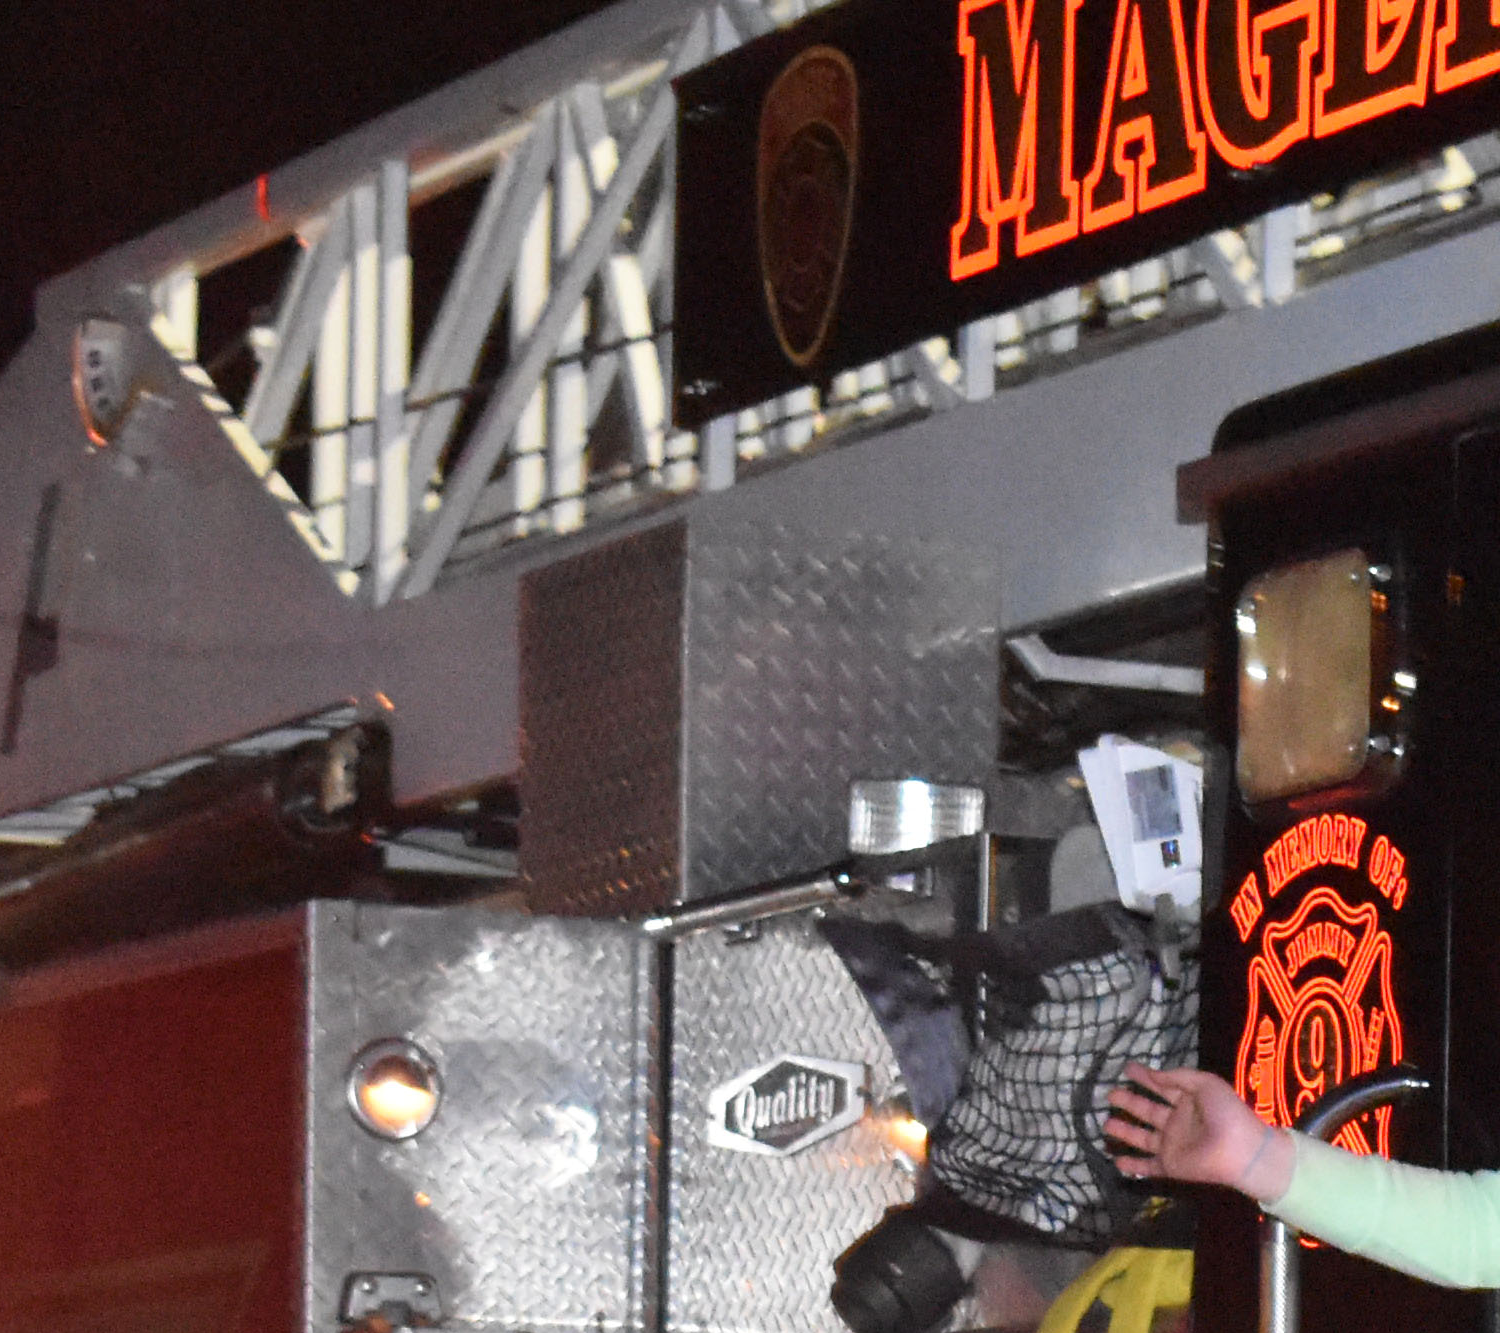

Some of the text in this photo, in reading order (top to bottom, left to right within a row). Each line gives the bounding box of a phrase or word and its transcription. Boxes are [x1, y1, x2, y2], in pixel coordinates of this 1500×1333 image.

[1230, 872, 1264, 943] IN
[1263, 814, 1367, 897] MEMORY
[1285, 922, 1357, 980] JIMMY
[735, 1071, 835, 1140] Quality
